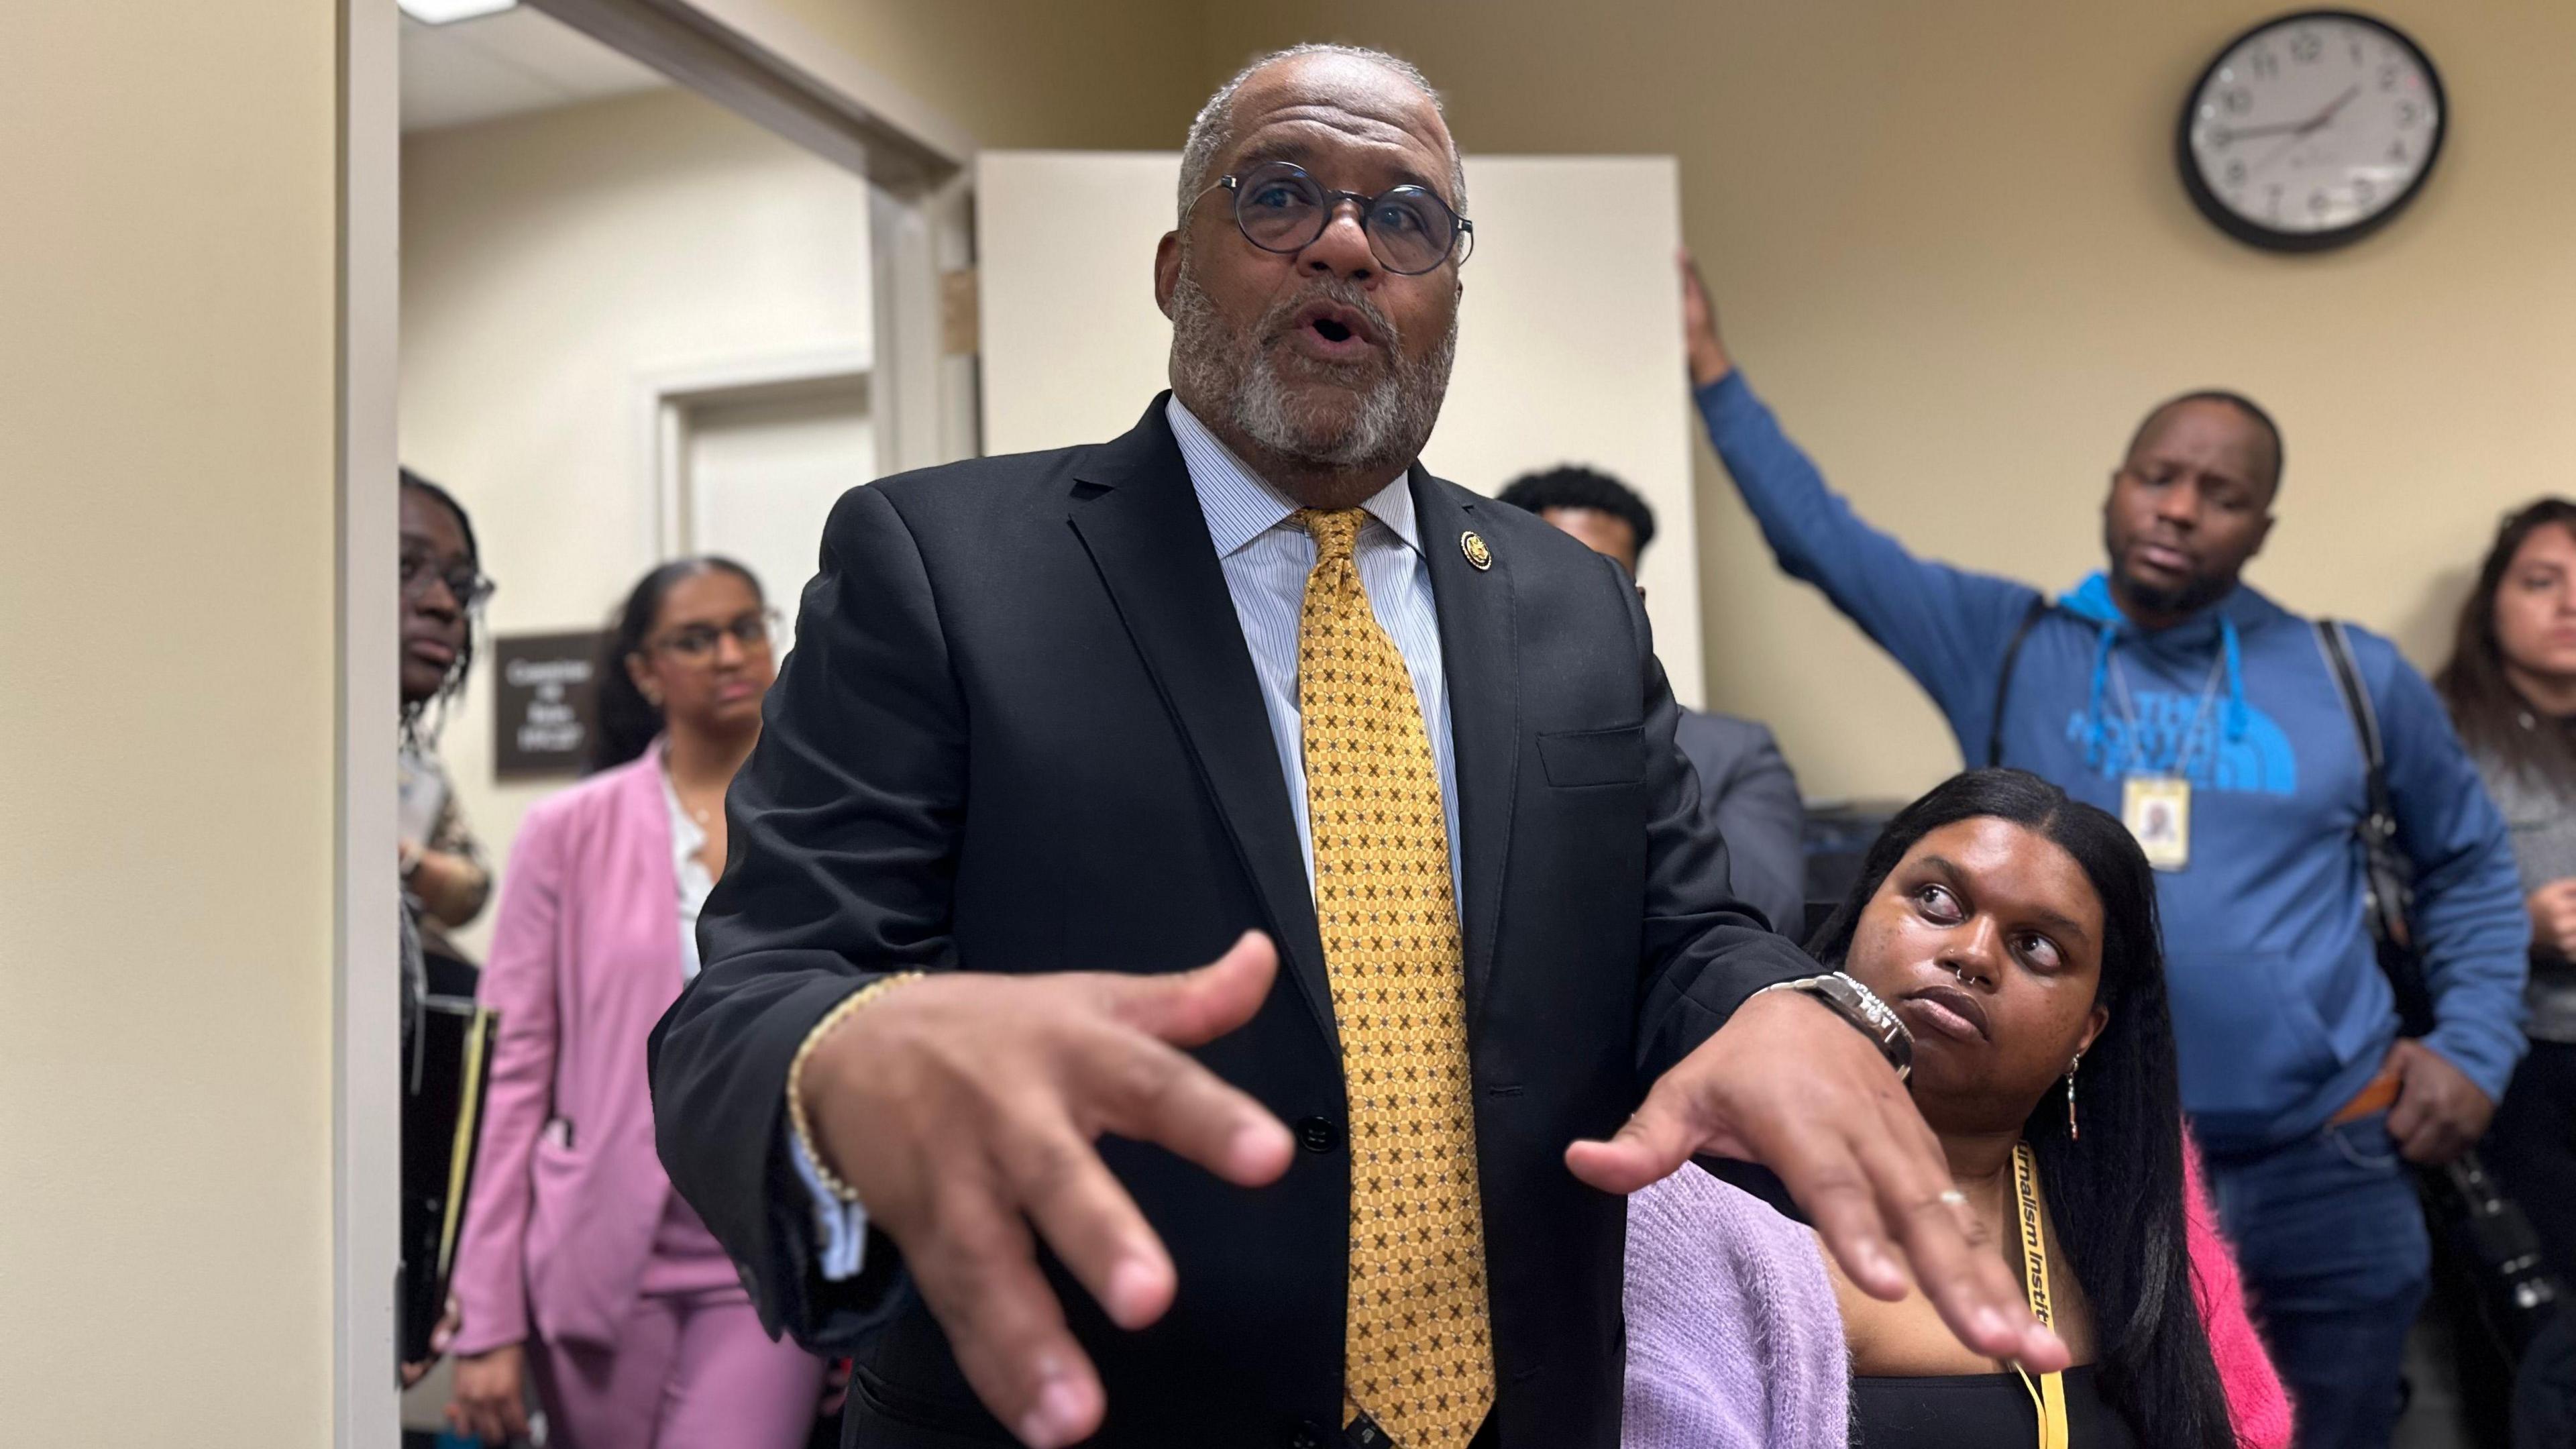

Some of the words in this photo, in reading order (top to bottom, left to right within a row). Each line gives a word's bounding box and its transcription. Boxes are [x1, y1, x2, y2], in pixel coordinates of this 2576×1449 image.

[2290, 32, 2323, 62] 12
[2251, 47, 2280, 80] 11
[2221, 87, 2253, 117] 10
[2396, 98, 2418, 130] 3
[2384, 138, 2407, 162] 4
[2226, 158, 2247, 187] 8
[2307, 186, 2331, 215] 6
[2029, 1250, 2049, 1327] Instit
